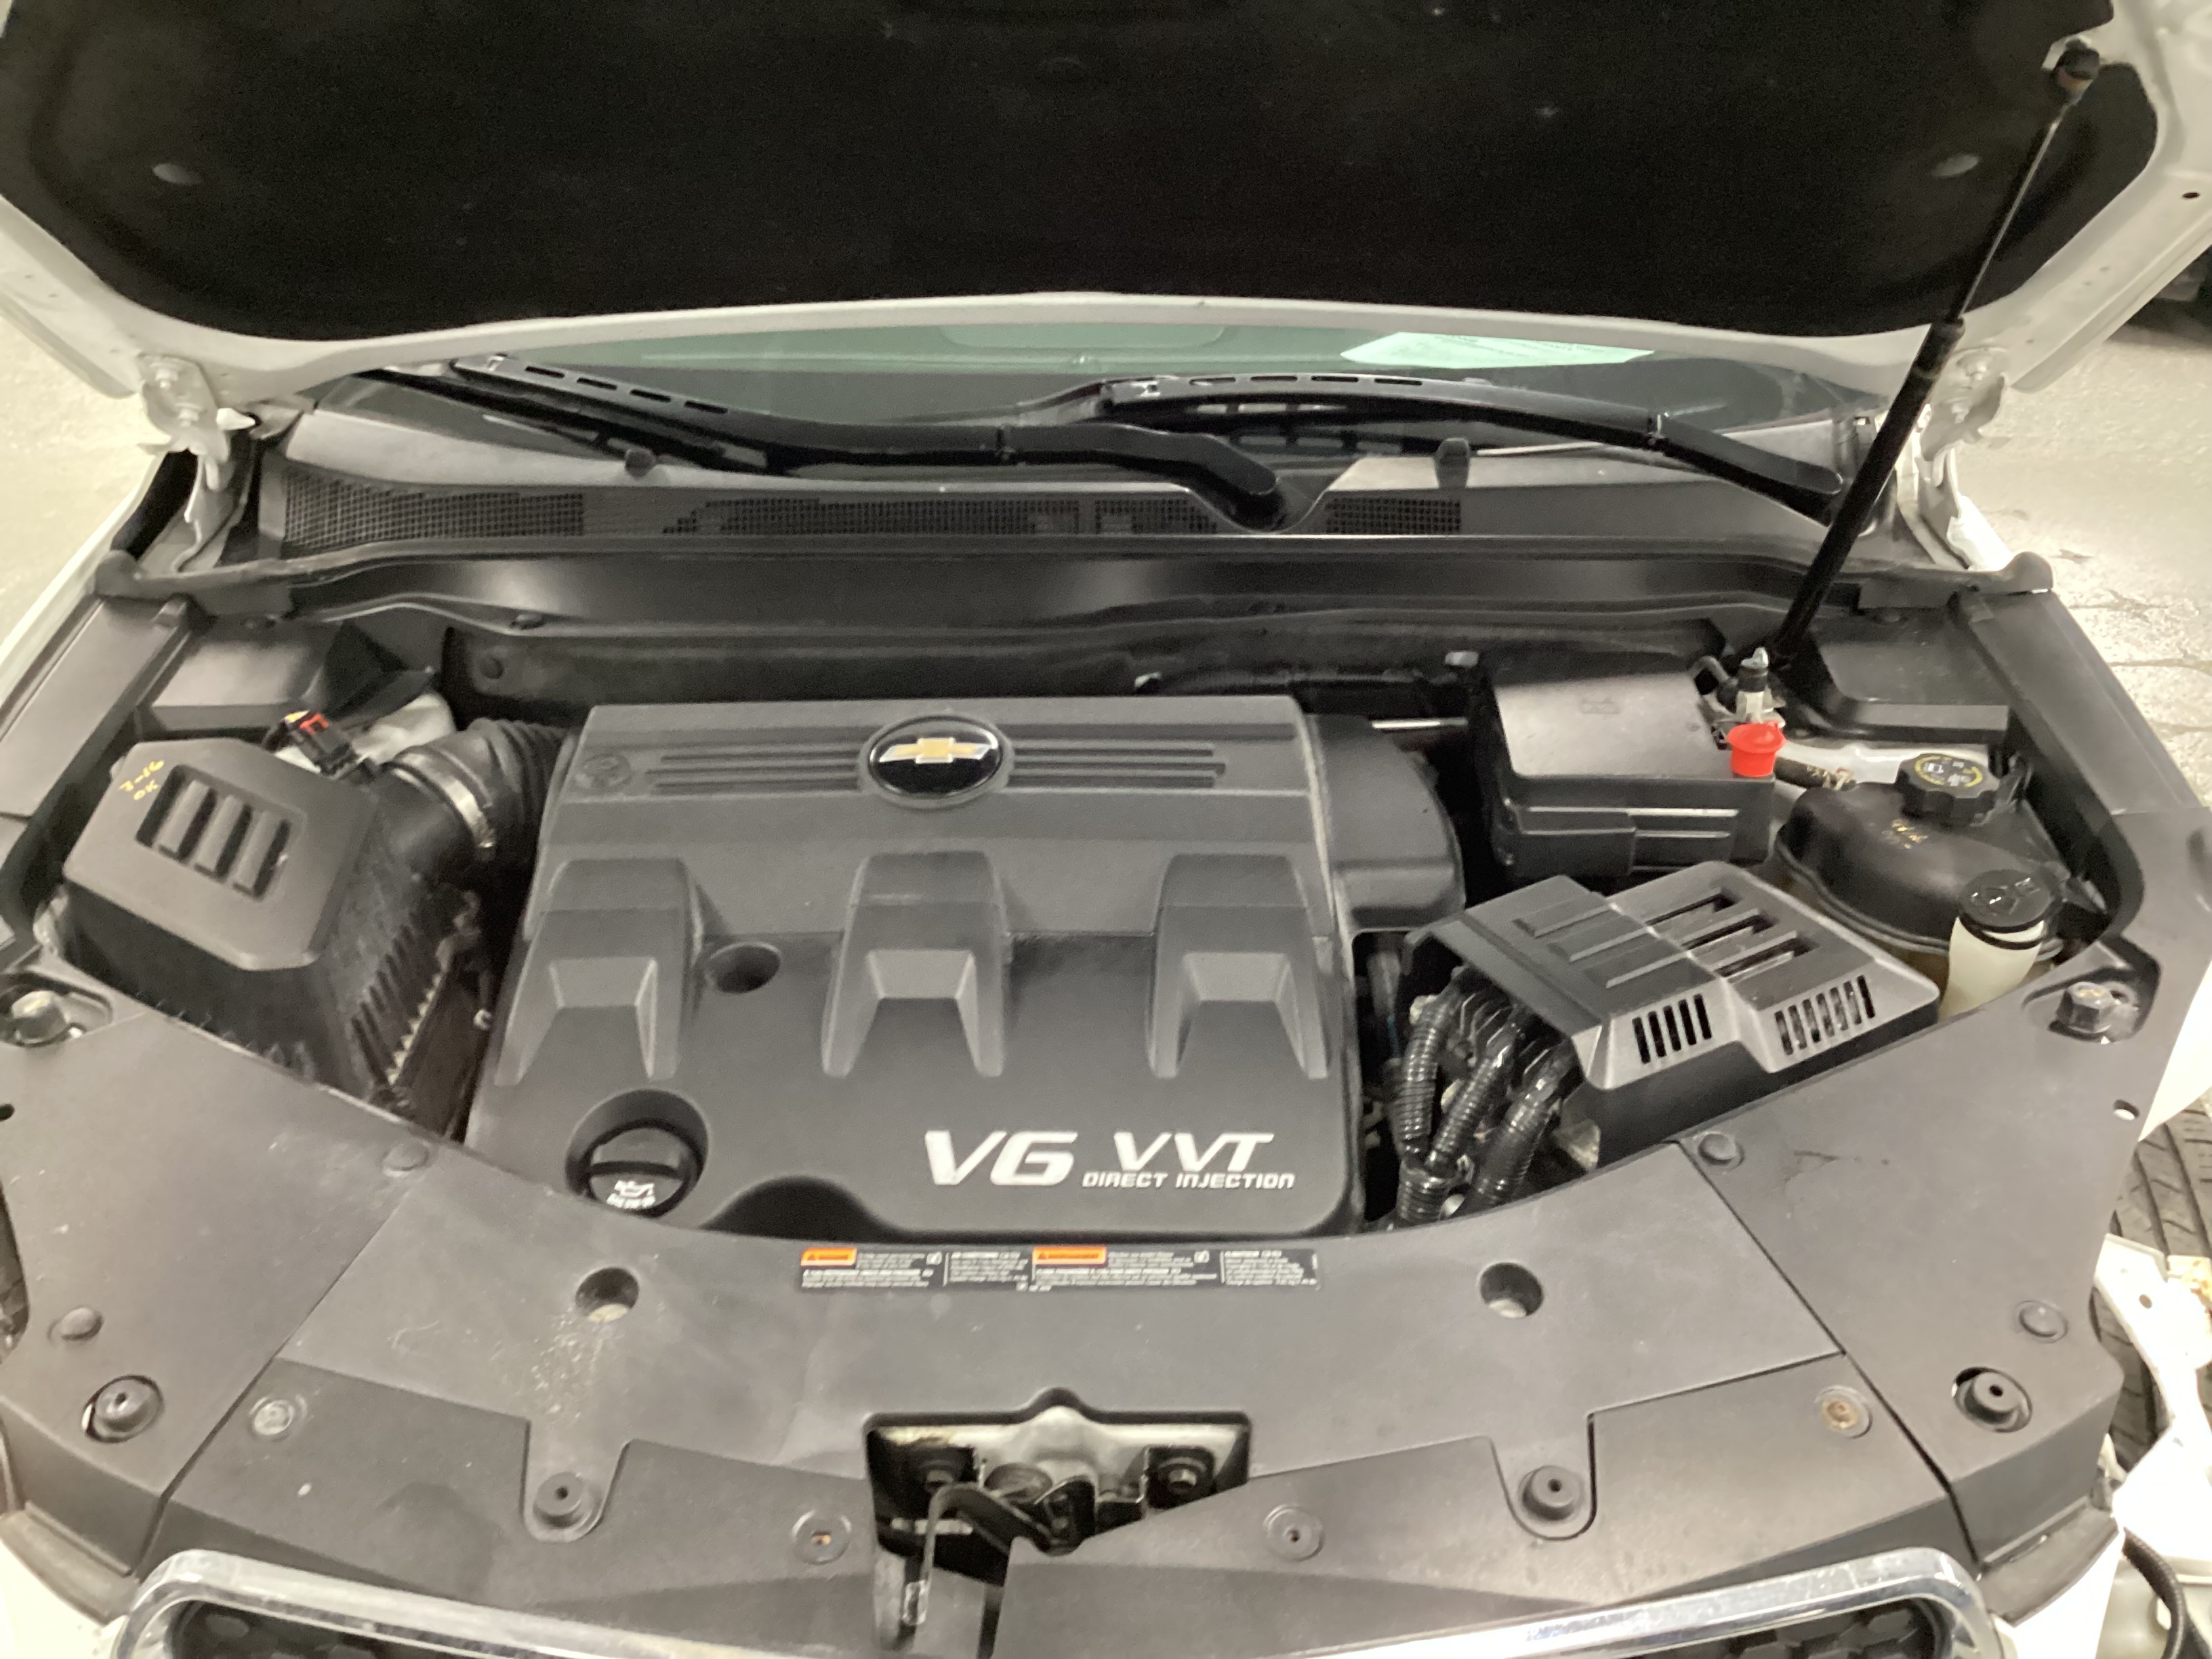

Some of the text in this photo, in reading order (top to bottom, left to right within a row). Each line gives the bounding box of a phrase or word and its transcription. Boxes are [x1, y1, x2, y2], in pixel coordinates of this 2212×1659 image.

[134, 779, 159, 800] OK
[924, 1130, 1274, 1185] V6 VVT
[1082, 1172, 1295, 1189] DIRECT INJECTION
